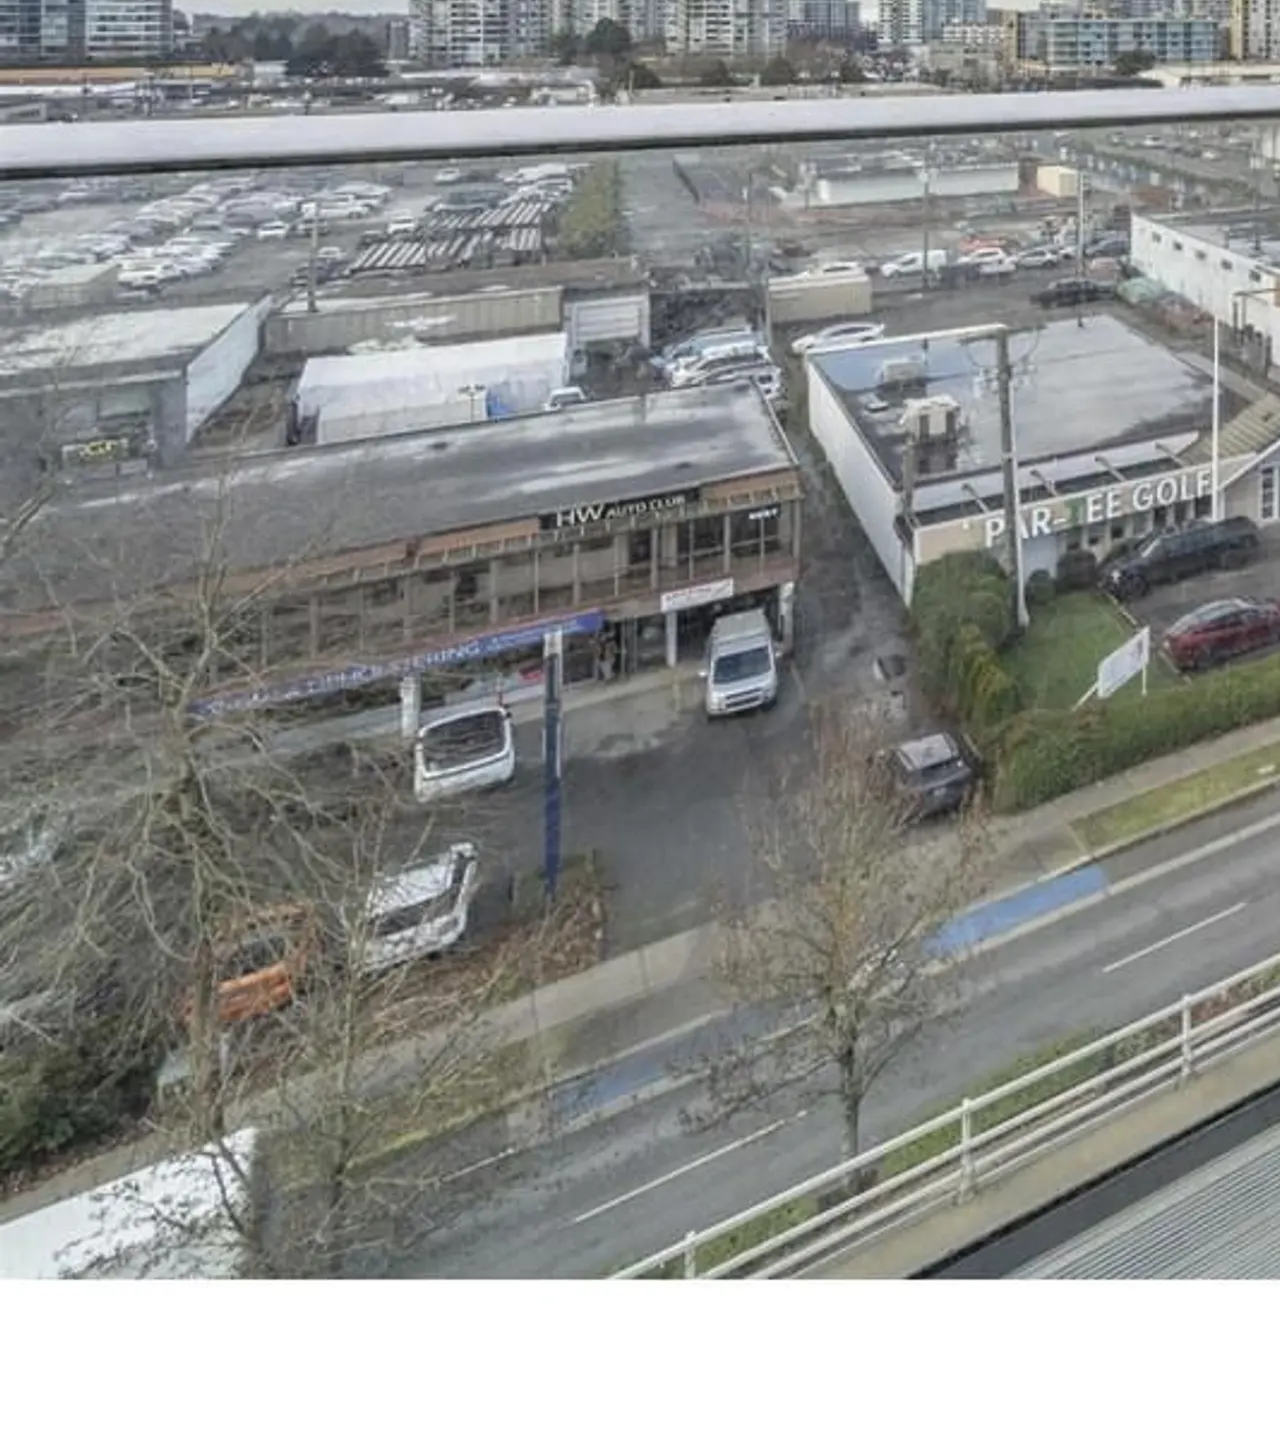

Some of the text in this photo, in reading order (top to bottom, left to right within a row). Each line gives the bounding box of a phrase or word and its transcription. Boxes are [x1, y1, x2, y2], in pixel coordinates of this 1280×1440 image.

[1132, 468, 1212, 512] GOLF
[556, 494, 685, 527] HW AUTO CLUB
